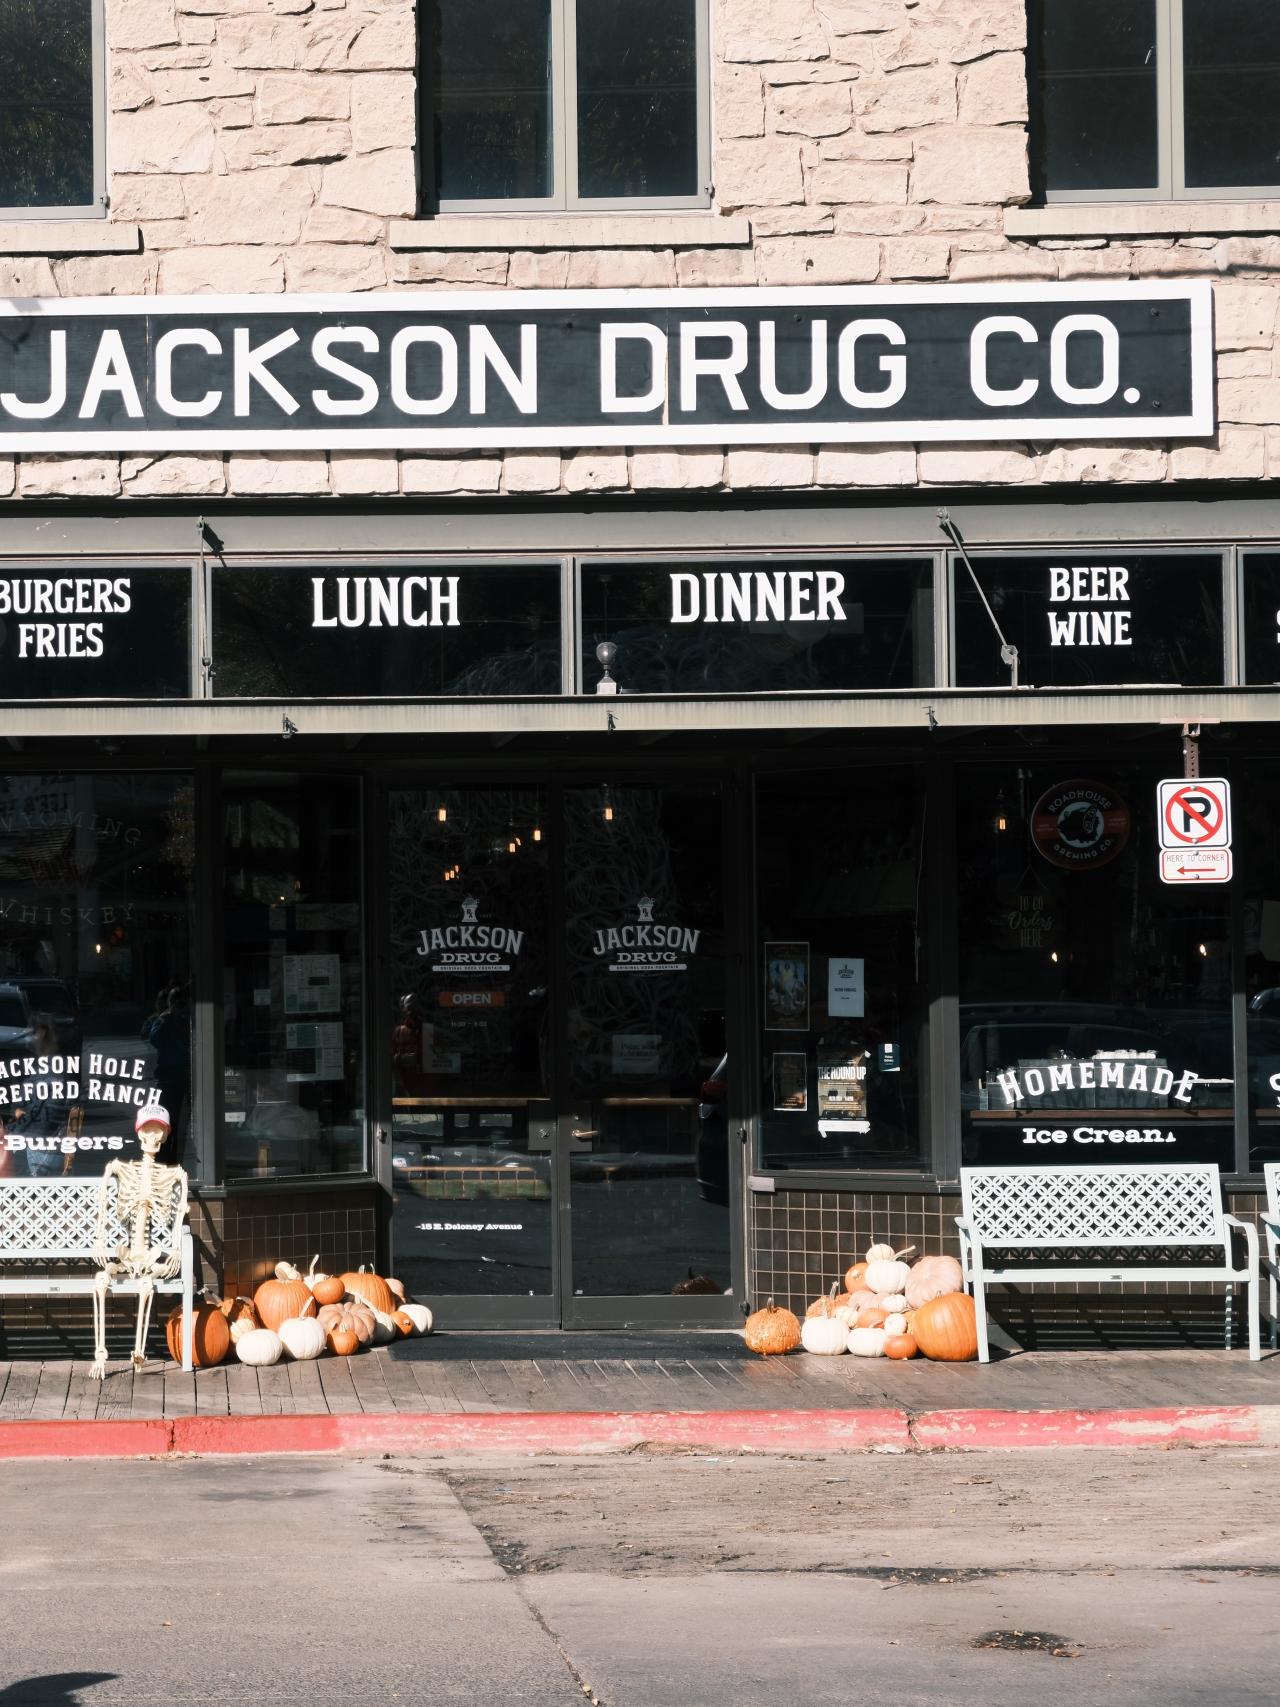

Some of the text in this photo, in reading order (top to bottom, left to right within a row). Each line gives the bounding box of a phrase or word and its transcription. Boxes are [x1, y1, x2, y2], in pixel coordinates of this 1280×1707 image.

[0, 313, 1141, 419] JACKSON DRUG CO.
[669, 570, 847, 623] DINNER
[1049, 566, 1131, 602] BEER
[311, 576, 461, 627] LUNCH
[18, 622, 104, 658] FRIES
[1047, 611, 1132, 646] WINE
[1048, 789, 1112, 812] ROADHOUSE
[1167, 854, 1184, 862] HERE
[1198, 853, 1225, 862] CORNER
[417, 926, 525, 956] JACKSON
[593, 925, 701, 955] JACKSON
[440, 953, 501, 963] DRUG
[617, 952, 677, 962] DRUG
[452, 993, 491, 1005] OPEN
[88, 1053, 146, 1081] HOLE
[818, 1066, 867, 1080] THE ROUND UP
[88, 1080, 163, 1108] RANCH
[996, 1062, 1199, 1105] HOMEMADE
[1022, 1127, 1068, 1144] Ice
[444, 1223, 485, 1231] Deloney
